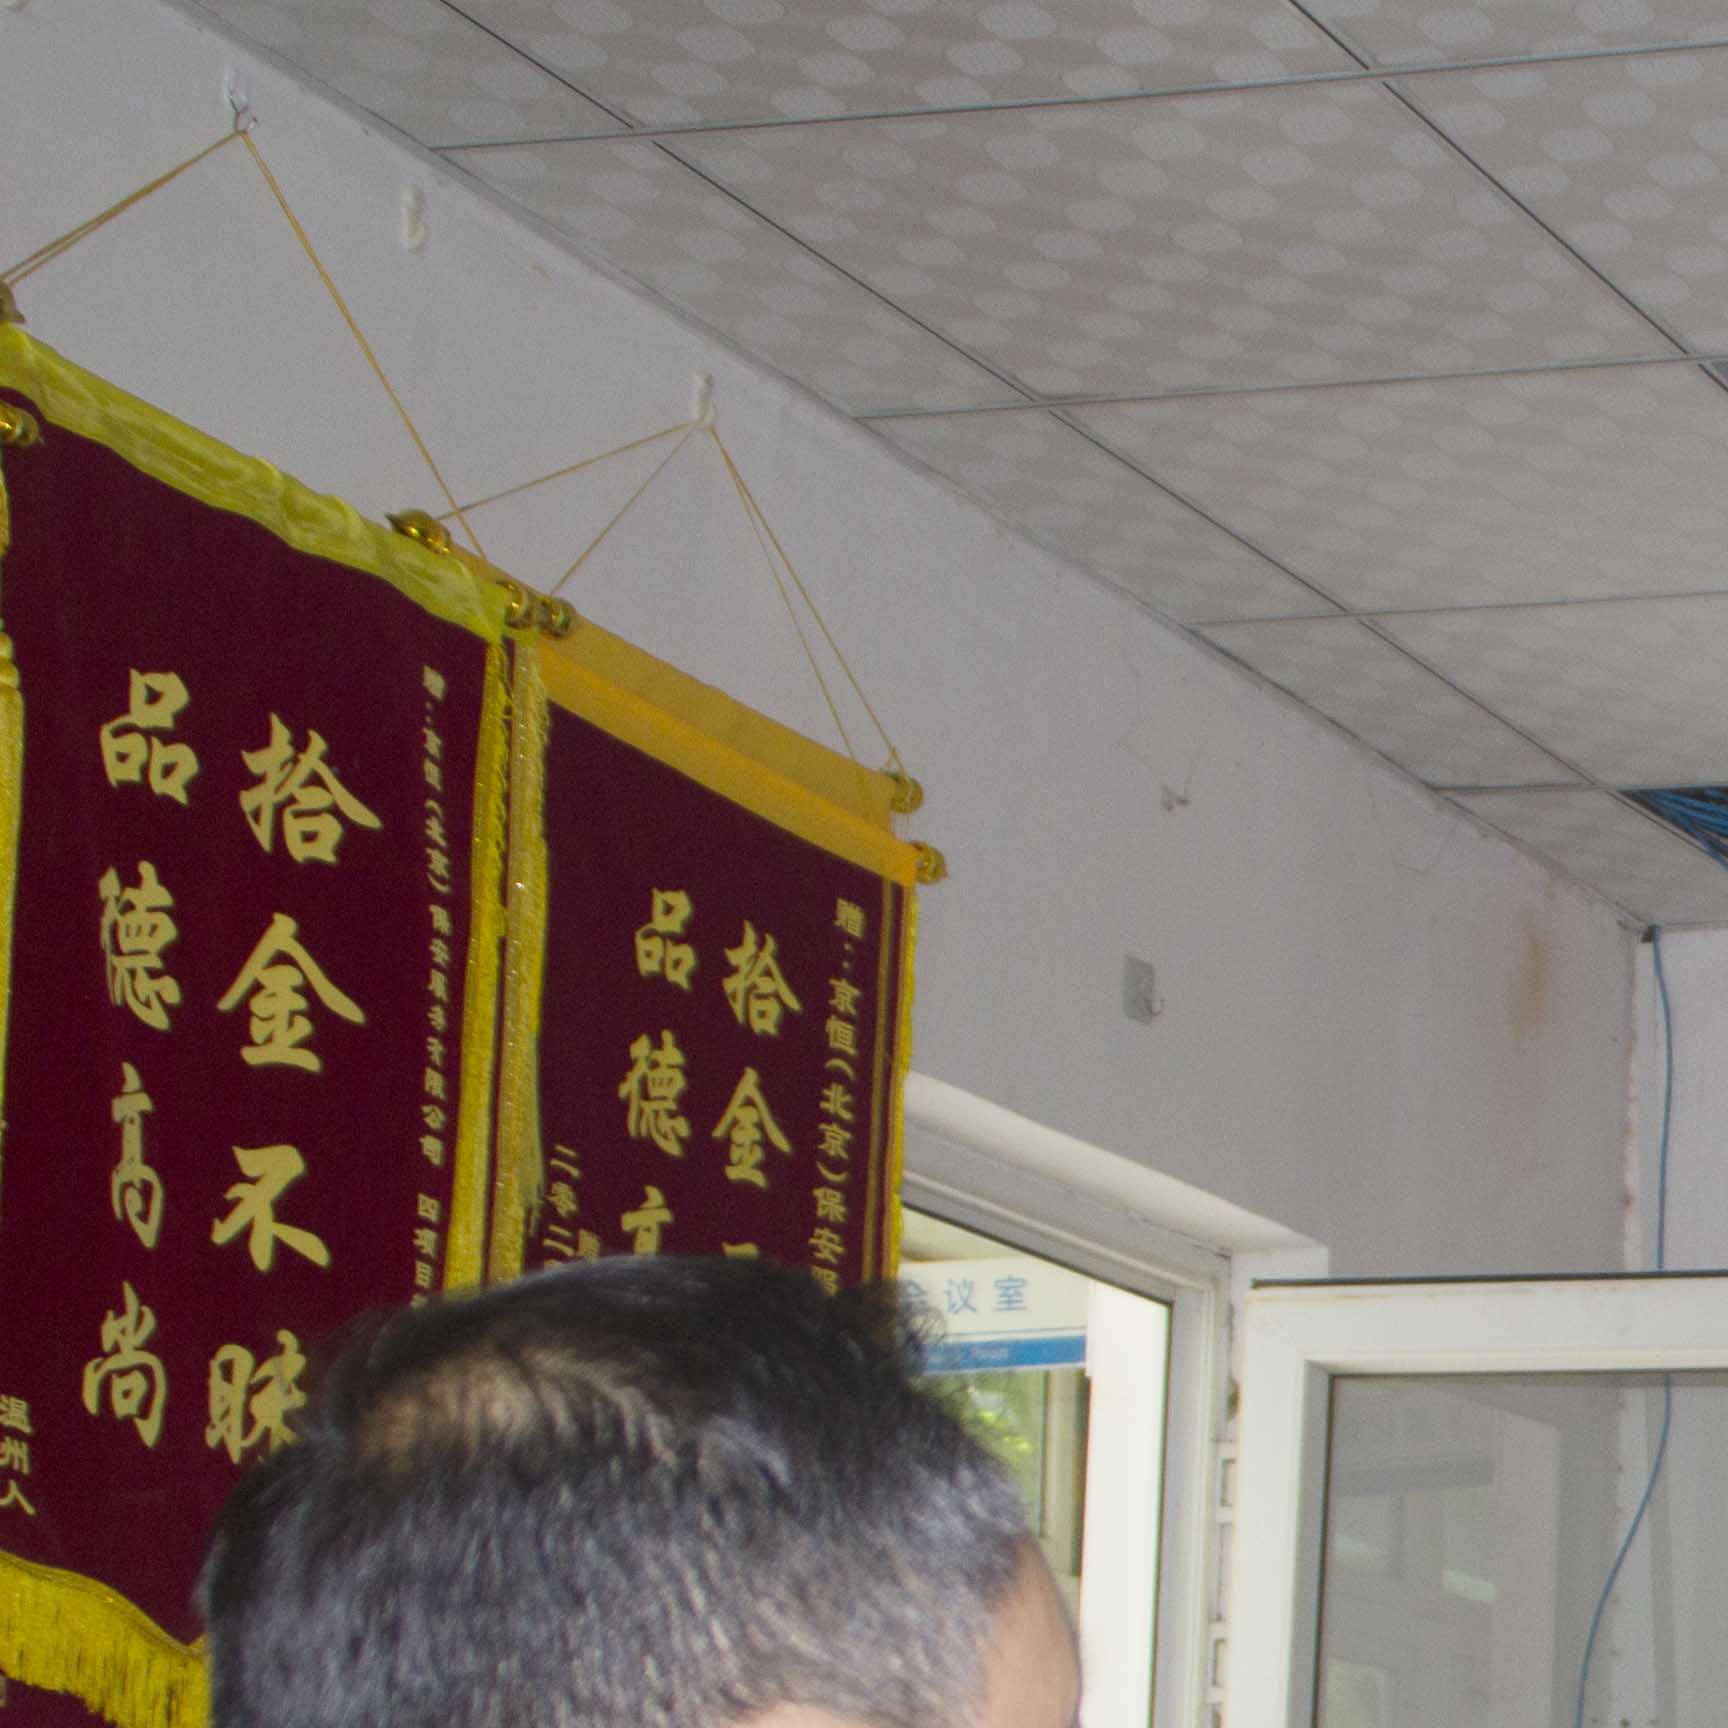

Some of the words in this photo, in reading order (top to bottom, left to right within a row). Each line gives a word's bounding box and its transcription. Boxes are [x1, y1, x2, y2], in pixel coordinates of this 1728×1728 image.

[83, 668, 199, 1448] 品德高尚
[206, 712, 381, 1464] 拾金不昧
[542, 1144, 580, 1268] 二零二
[712, 920, 801, 1259] 拾金
